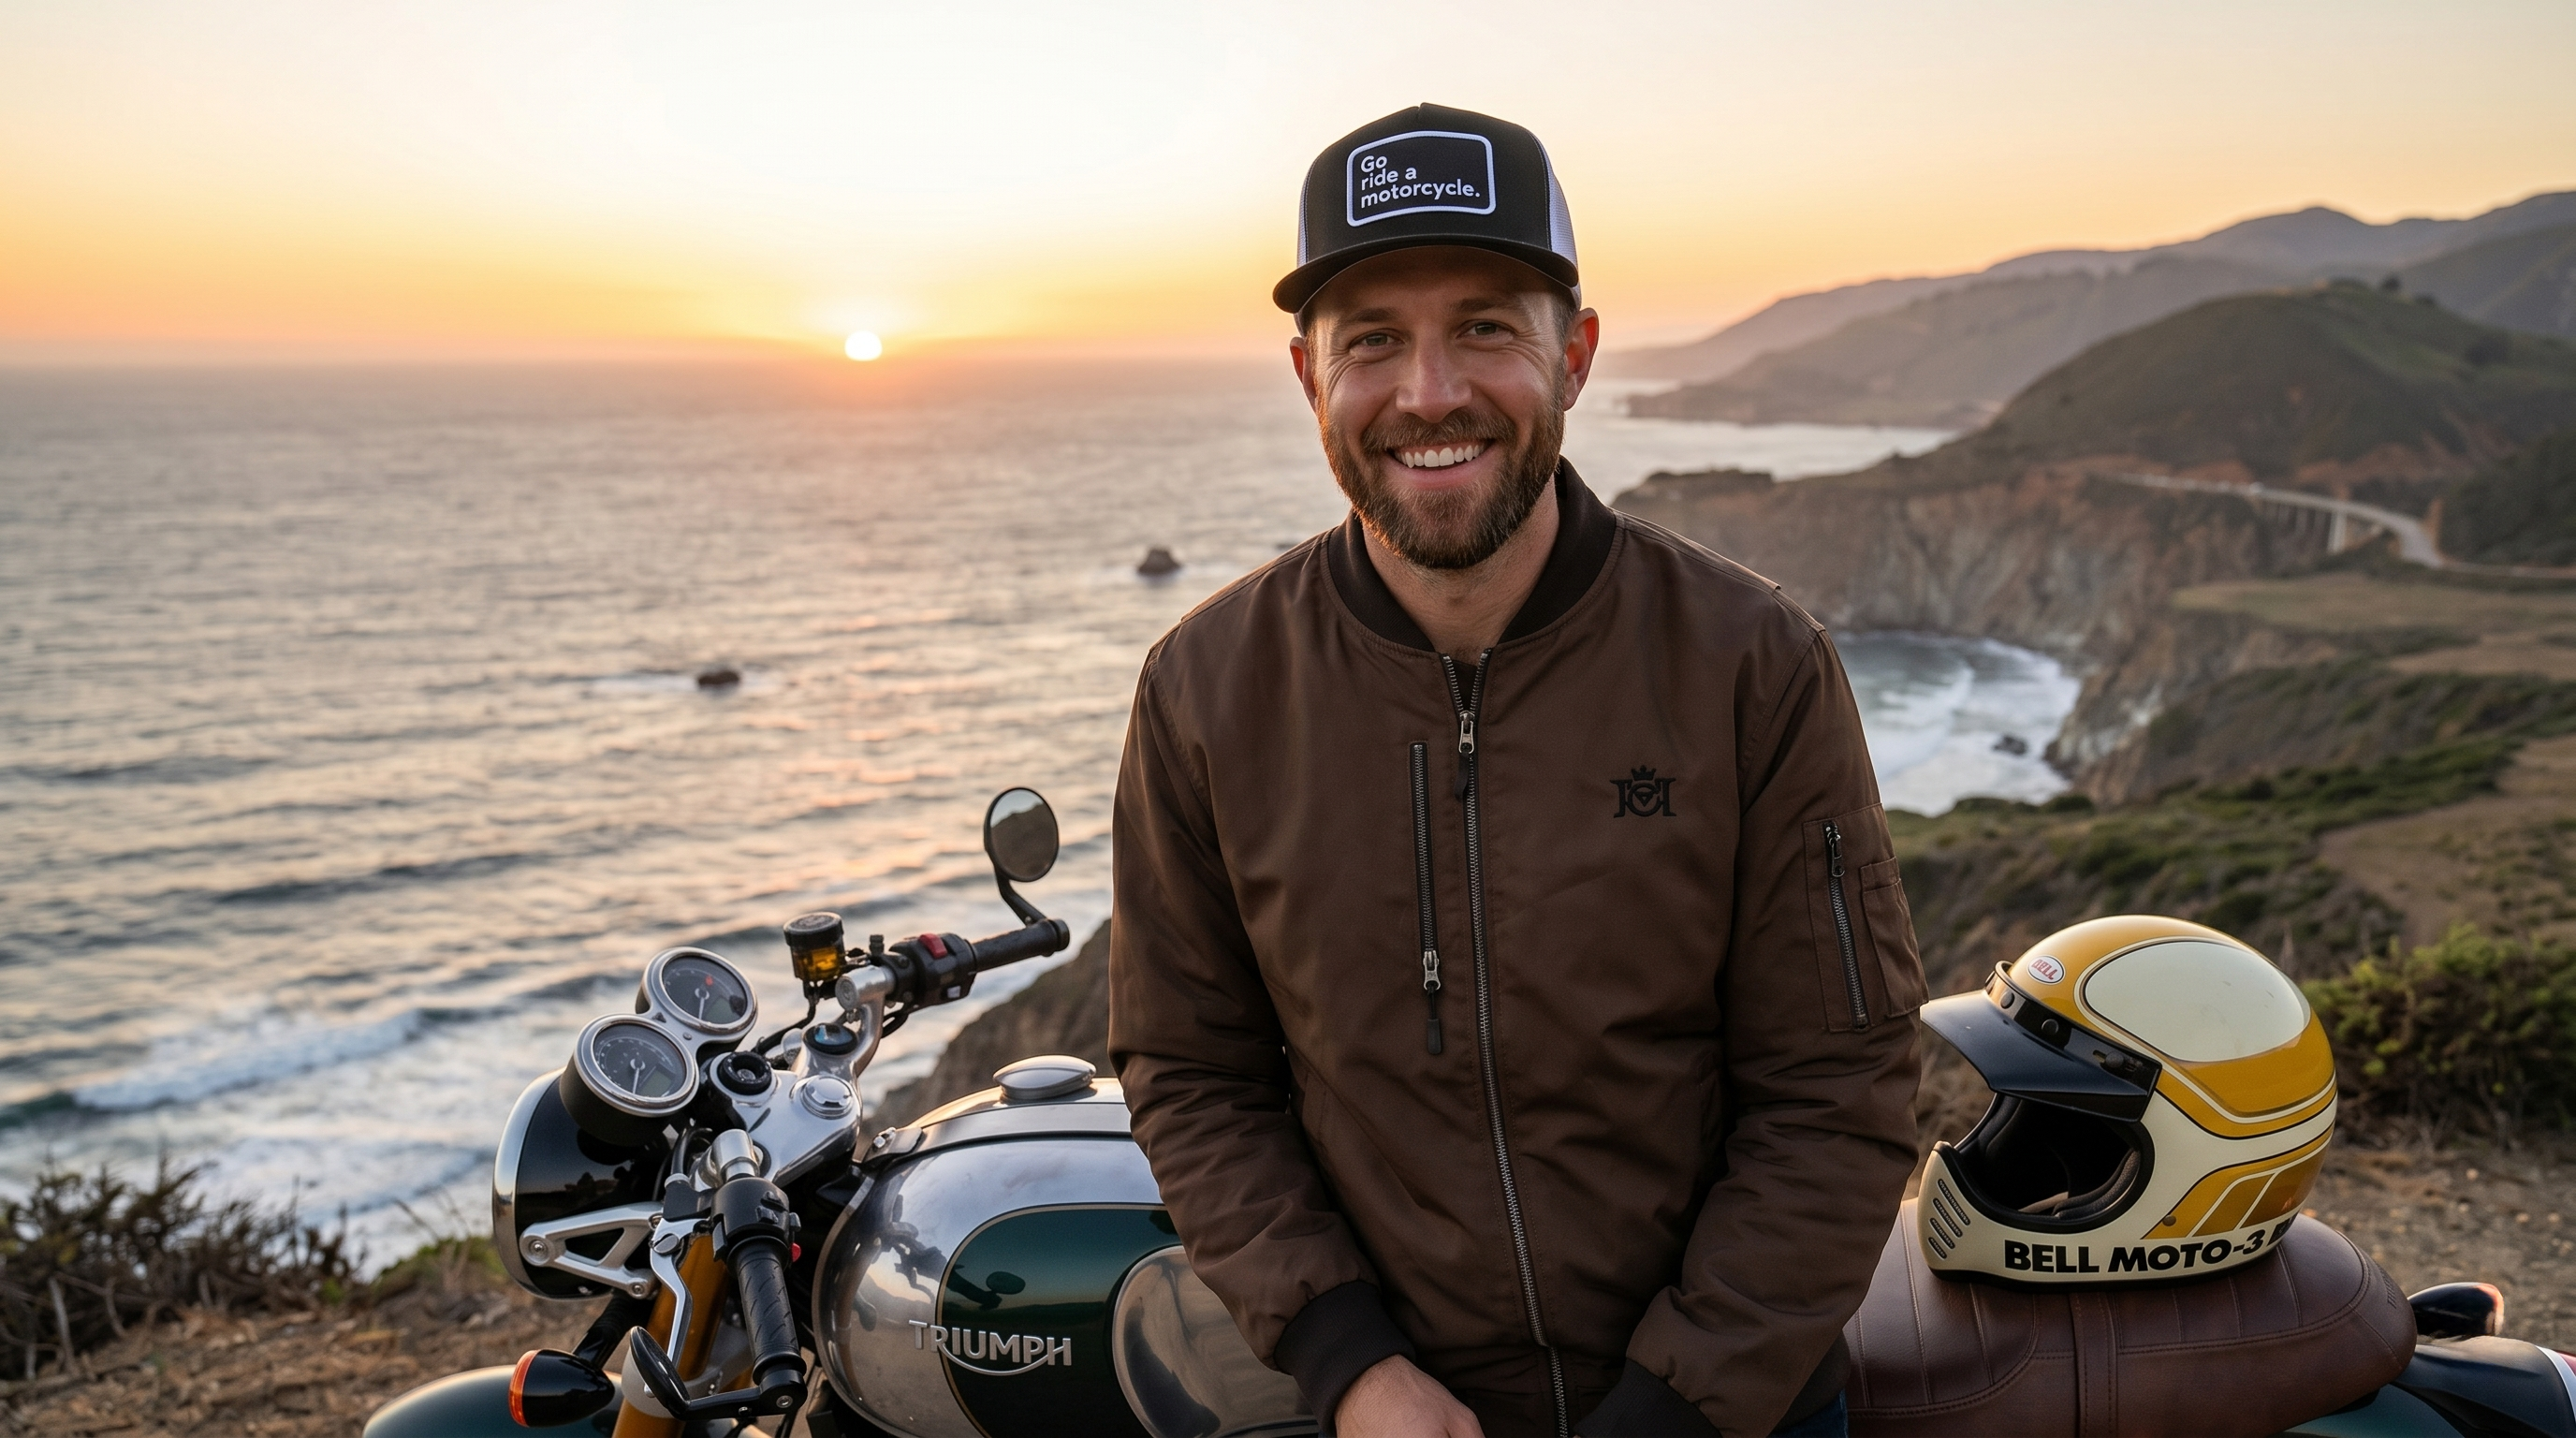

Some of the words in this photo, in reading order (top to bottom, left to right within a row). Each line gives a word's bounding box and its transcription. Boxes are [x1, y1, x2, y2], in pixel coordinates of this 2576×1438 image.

[1360, 155, 1388, 173] Go
[1361, 168, 1398, 191] ride
[1404, 167, 1417, 181] a
[1360, 178, 1481, 209] motorcycle.
[2004, 1239, 2100, 1273] BELL
[2107, 1229, 2266, 1272] MOTO-3
[908, 1319, 1073, 1376] TRIUMPH
